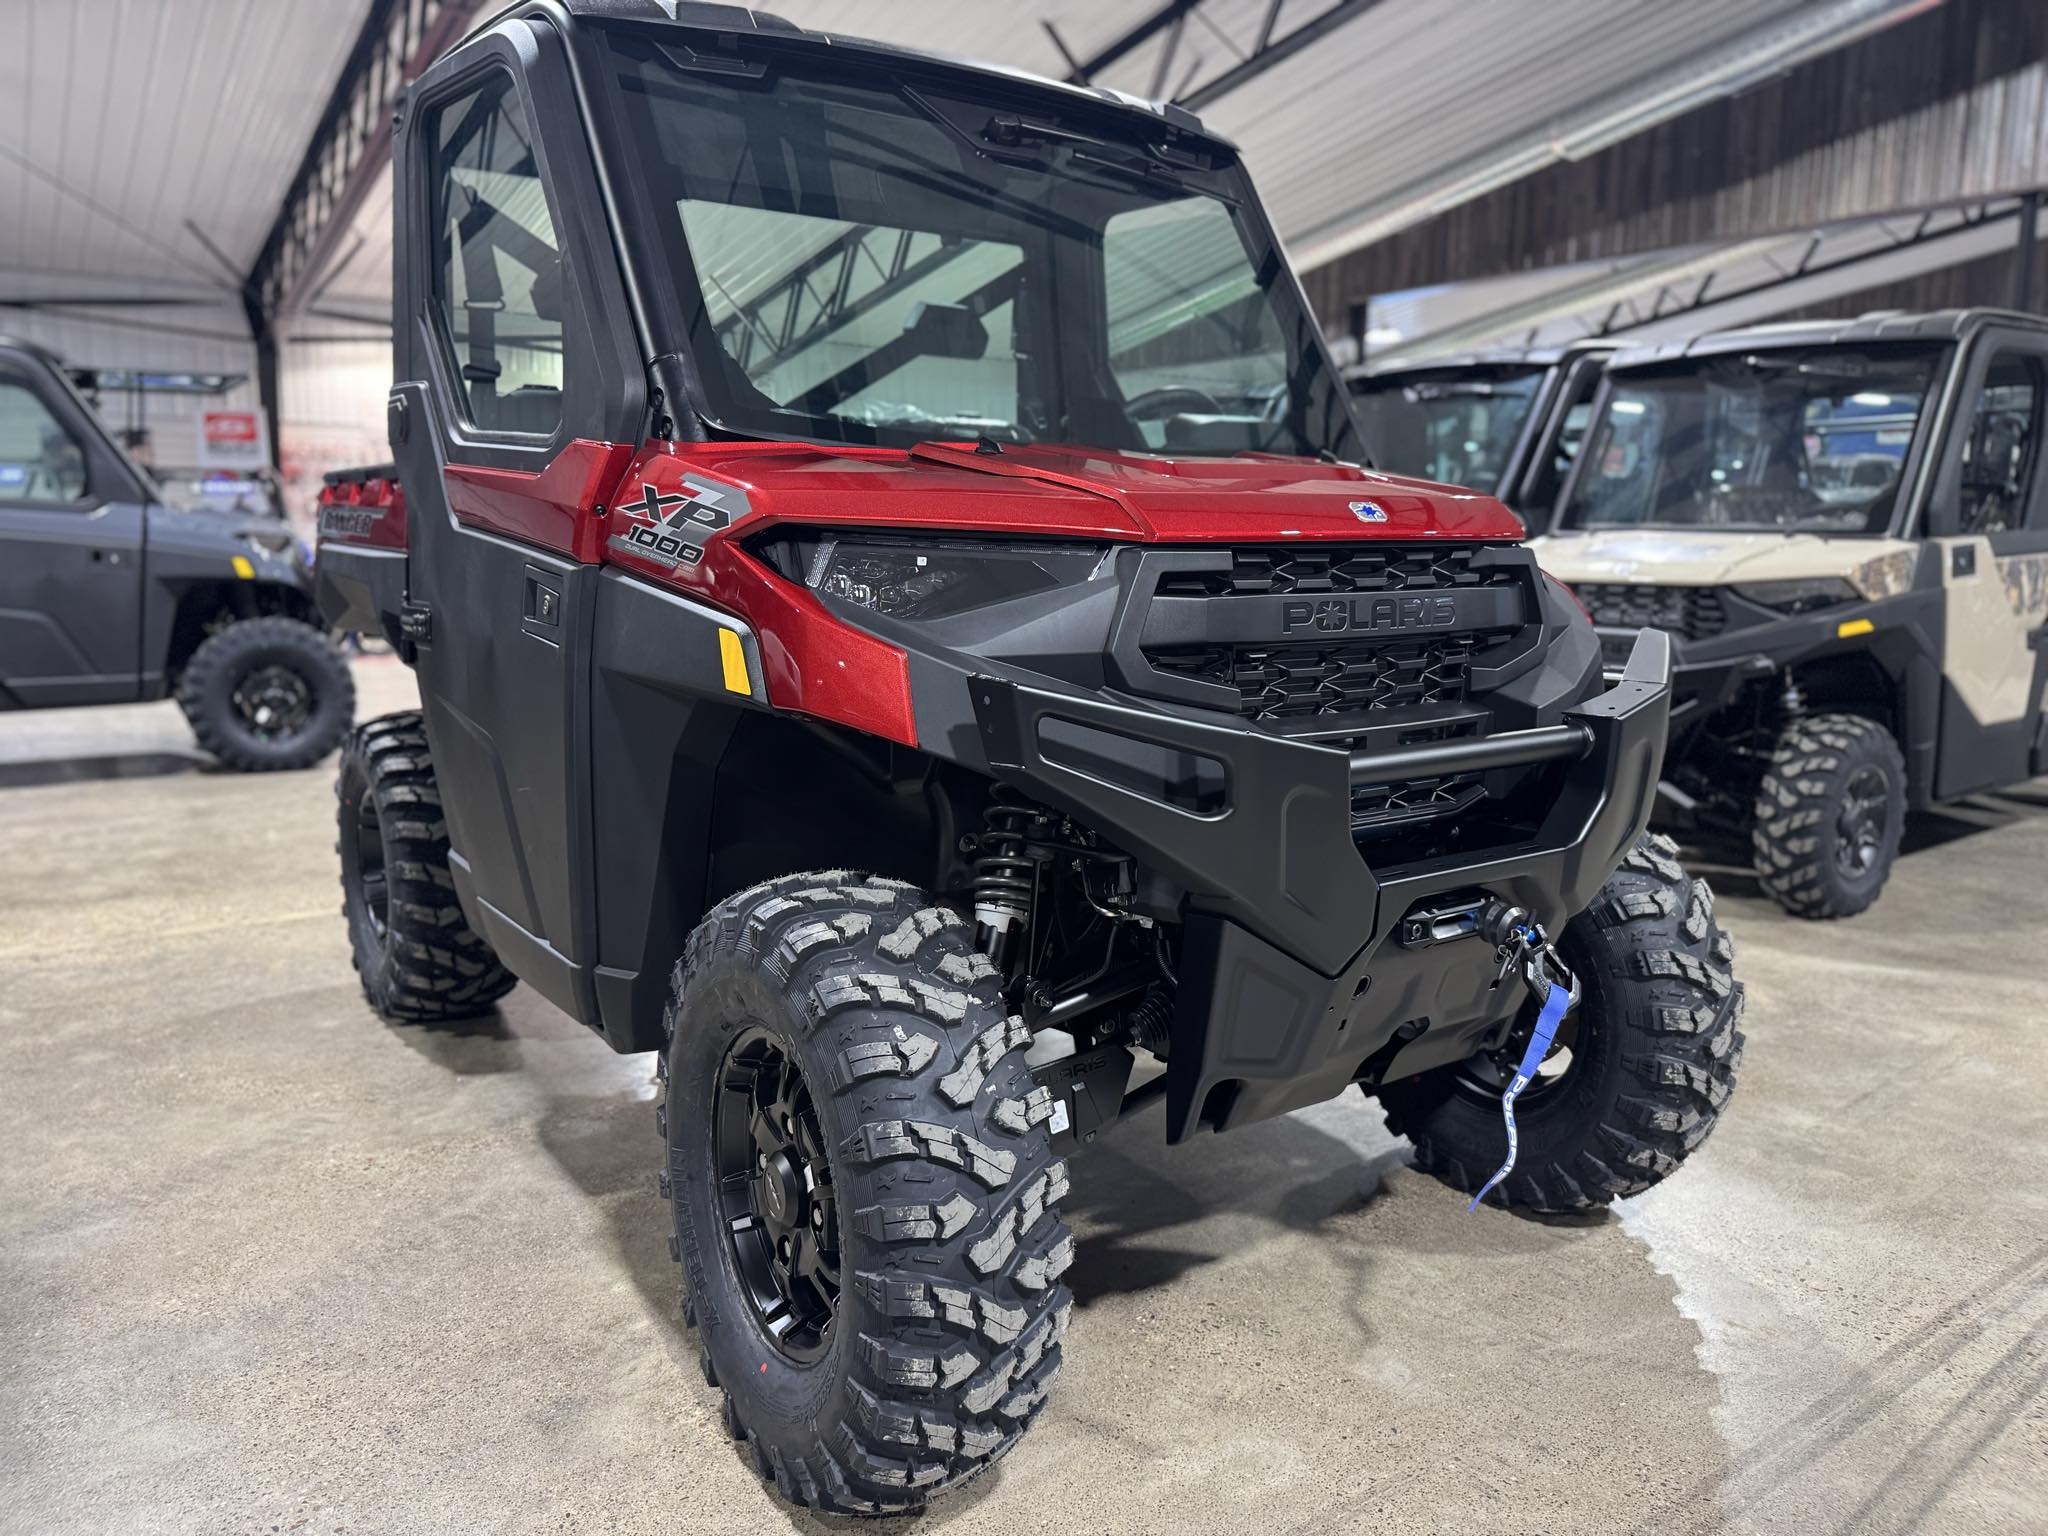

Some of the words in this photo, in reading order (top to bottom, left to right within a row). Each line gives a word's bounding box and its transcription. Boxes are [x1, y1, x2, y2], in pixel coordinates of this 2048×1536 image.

[615, 482, 731, 532] XP
[628, 523, 704, 566] 1000
[1282, 596, 1456, 635] POLARIS
